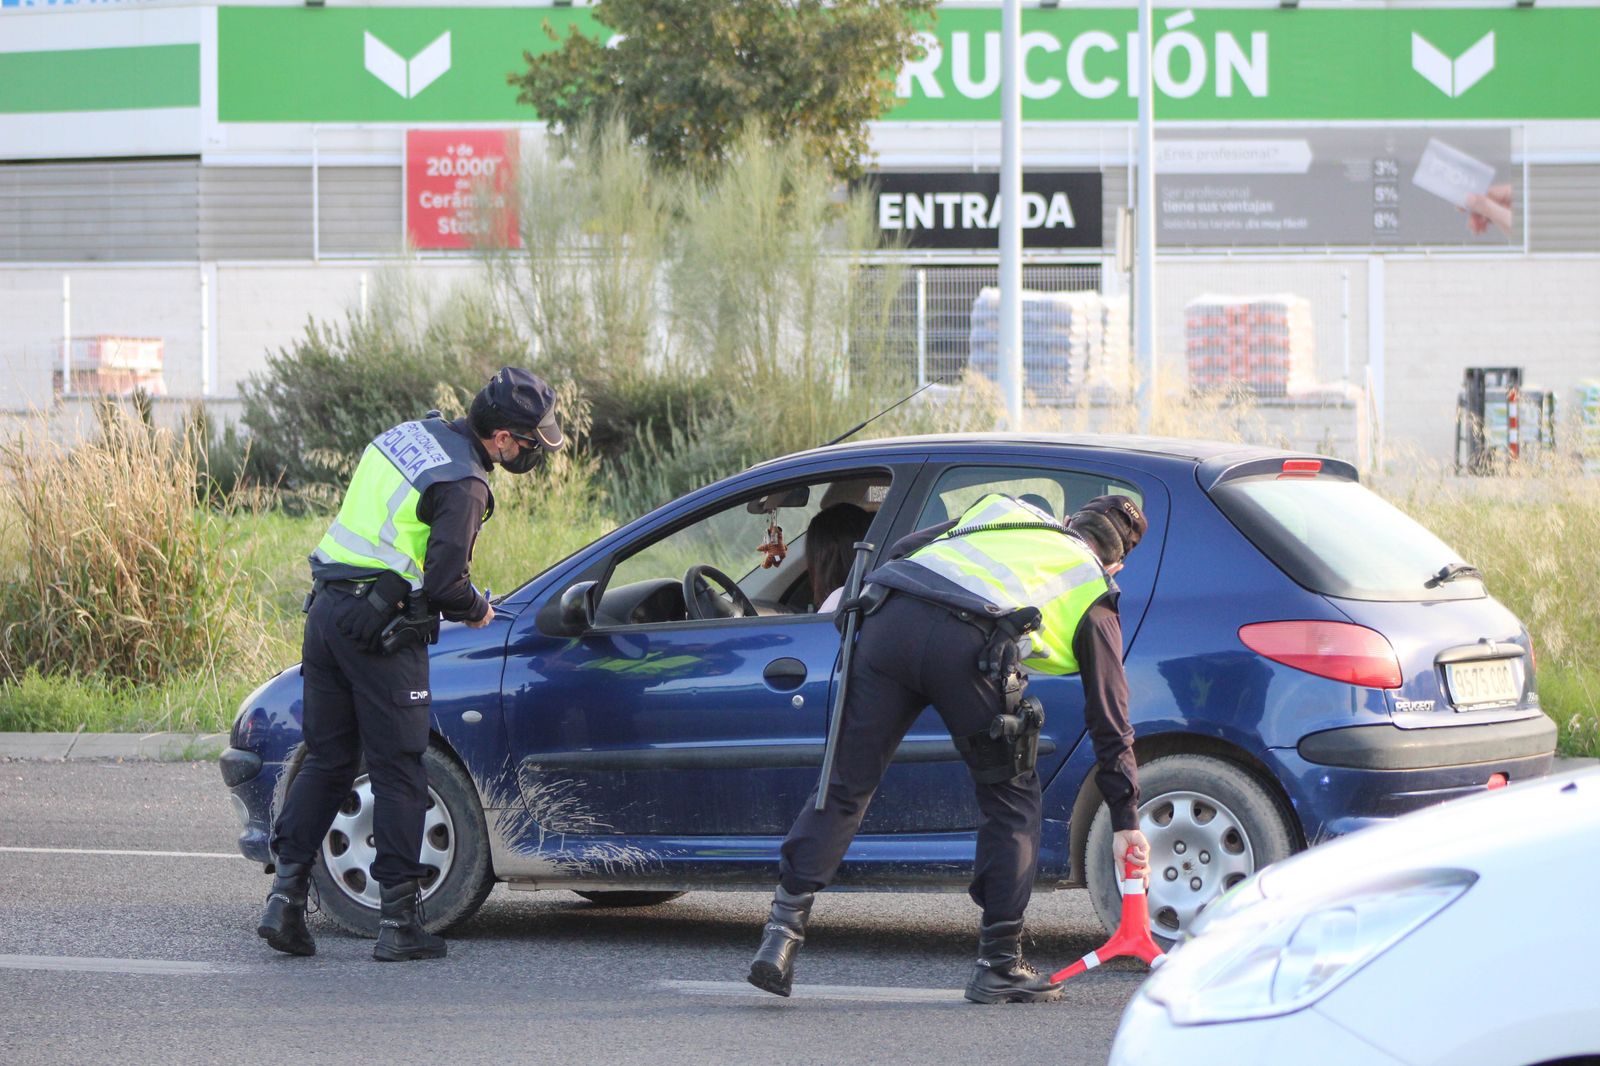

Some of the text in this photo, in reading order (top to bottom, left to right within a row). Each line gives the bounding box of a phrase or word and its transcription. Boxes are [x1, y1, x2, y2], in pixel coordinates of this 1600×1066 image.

[1196, 147, 1279, 163] profesional?
[1162, 200, 1195, 213] tiene
[1219, 200, 1274, 215] ventajas
[1123, 502, 1140, 519] CNP
[410, 690, 428, 700] CNP
[1395, 700, 1436, 712] PEUGEOT
